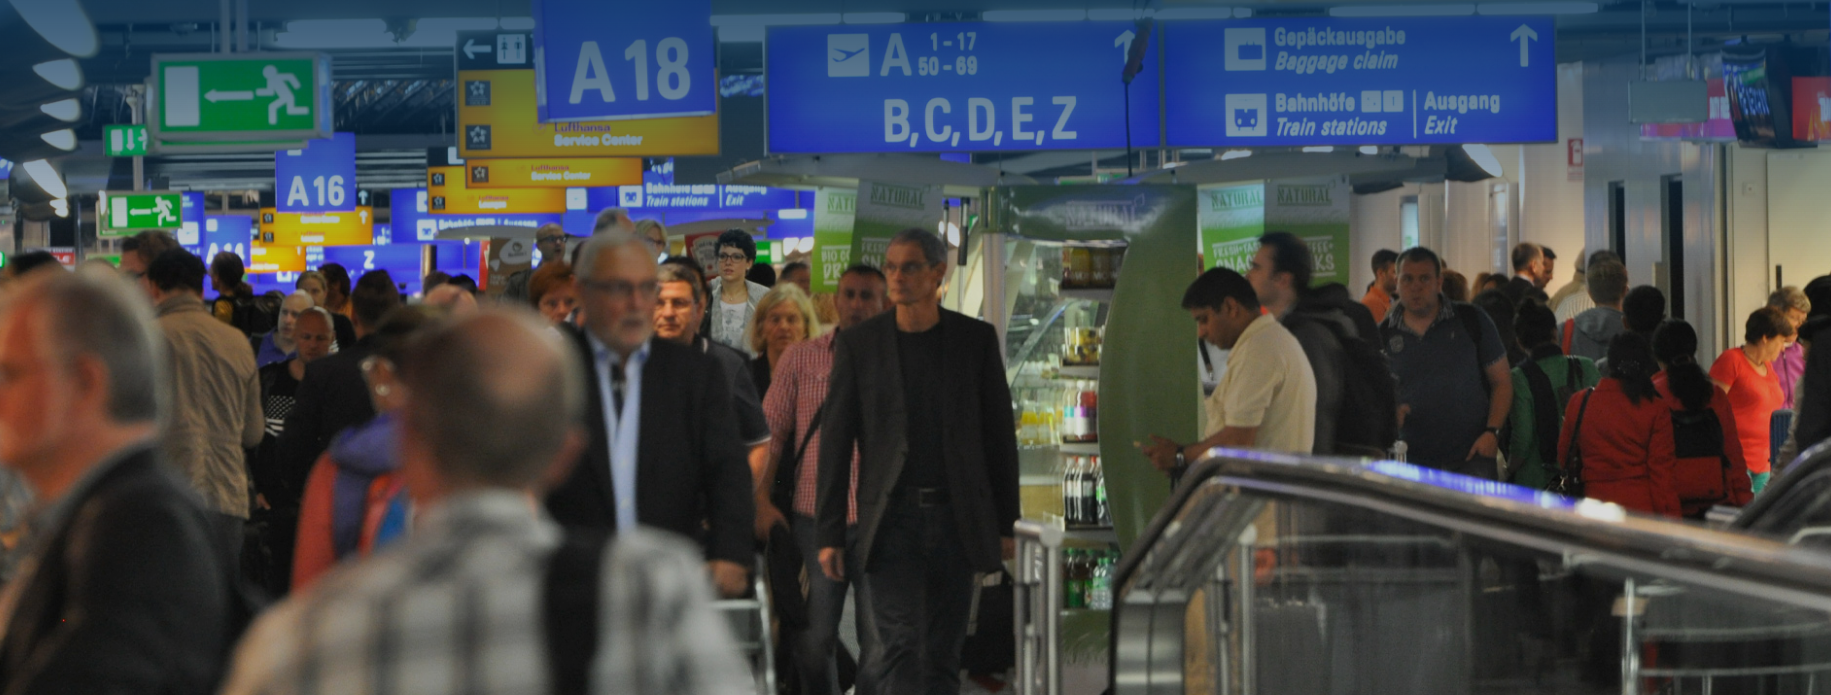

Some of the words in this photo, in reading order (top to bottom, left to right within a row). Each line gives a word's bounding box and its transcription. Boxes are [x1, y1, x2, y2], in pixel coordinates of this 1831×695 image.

[1274, 26, 1406, 49] Gepäckausgabe
[880, 33, 912, 76] A
[1275, 51, 1348, 74] Baggage
[1353, 50, 1399, 69] claim
[1275, 92, 1355, 112] Bahnhöfe
[1424, 91, 1500, 114] Ausgang
[554, 121, 611, 133] Lufthansa
[1276, 117, 1316, 136] Train
[1321, 117, 1388, 136] stations
[1424, 115, 1458, 134] Exit
[554, 134, 600, 147] Service
[602, 133, 643, 146] Center
[530, 171, 561, 181] Service
[563, 171, 591, 180] Center
[646, 195, 669, 207] Train
[671, 194, 709, 207] stations
[726, 194, 744, 206] Exit
[871, 185, 924, 207] NATURAL
[1277, 186, 1331, 203] NATURAL
